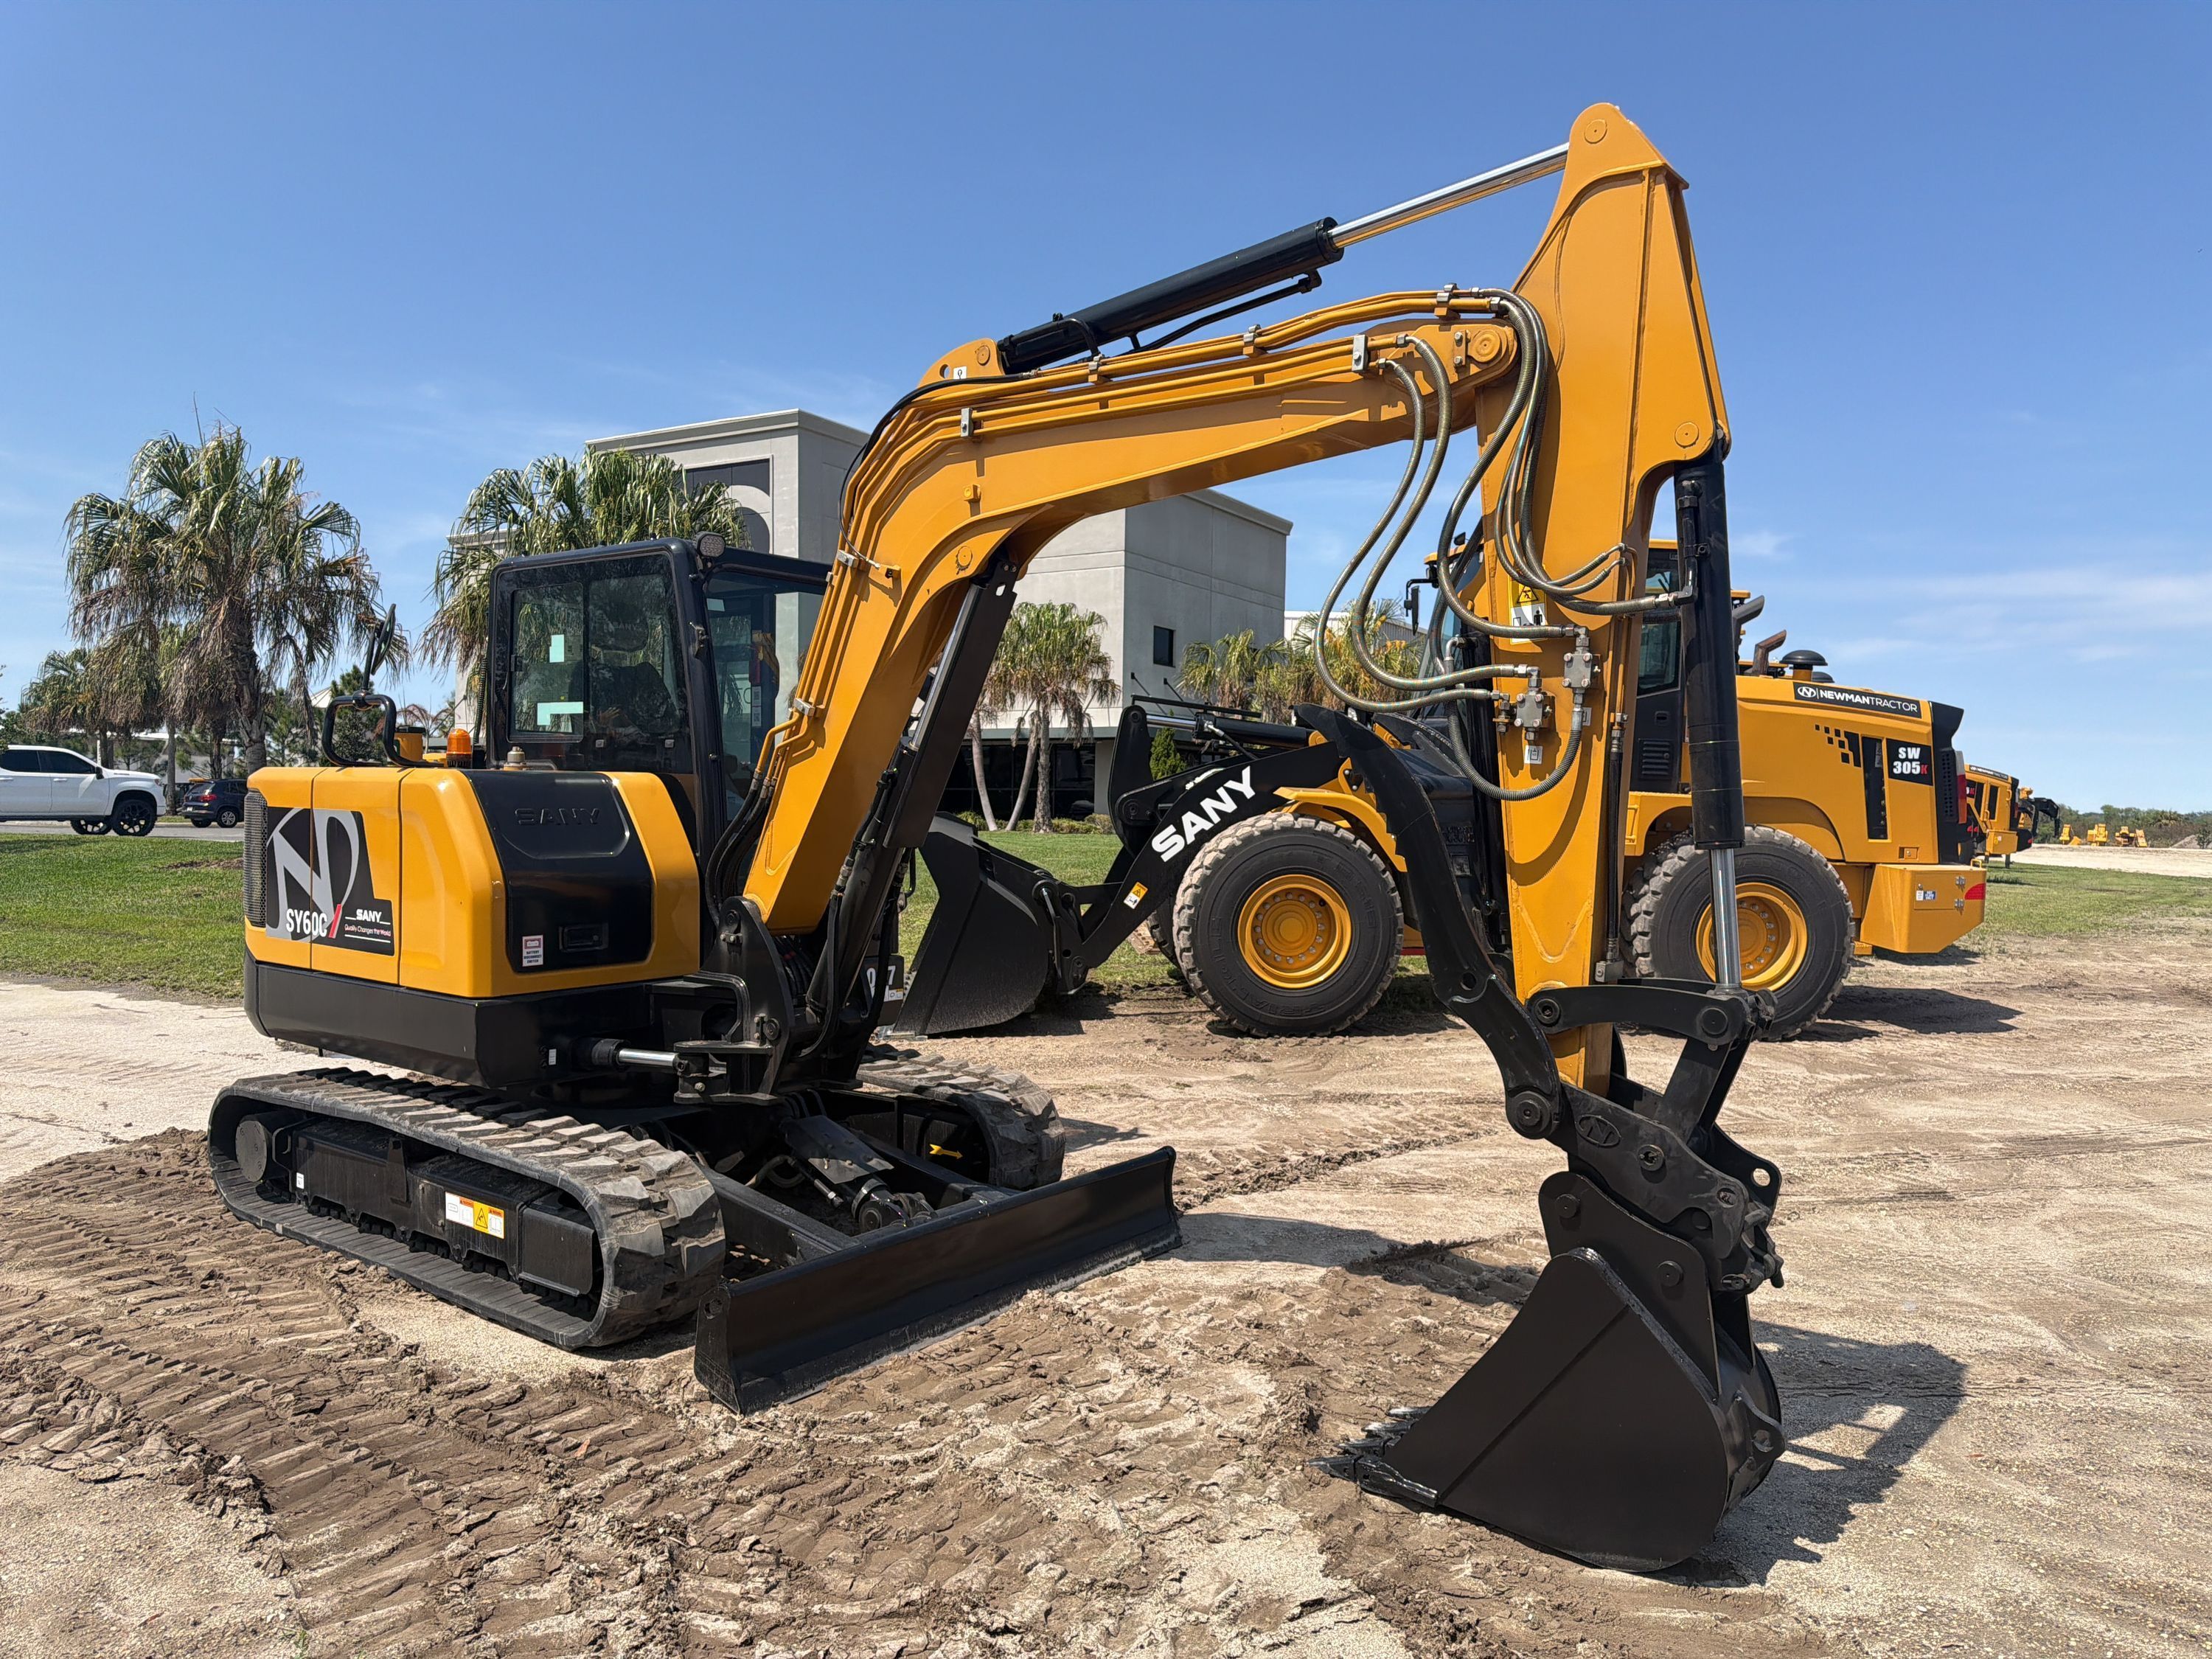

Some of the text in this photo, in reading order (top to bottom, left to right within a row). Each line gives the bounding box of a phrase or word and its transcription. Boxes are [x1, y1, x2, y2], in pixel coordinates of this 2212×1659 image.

[1820, 689, 1918, 713] NEWMANTRACTOR
[1898, 746, 1921, 759] SW
[1893, 761, 1929, 775] 305K
[514, 807, 601, 825] SANY
[1152, 765, 1256, 863] SANY
[286, 908, 327, 938] SY60C
[356, 908, 382, 922] SANY
[344, 923, 357, 933] Quality
